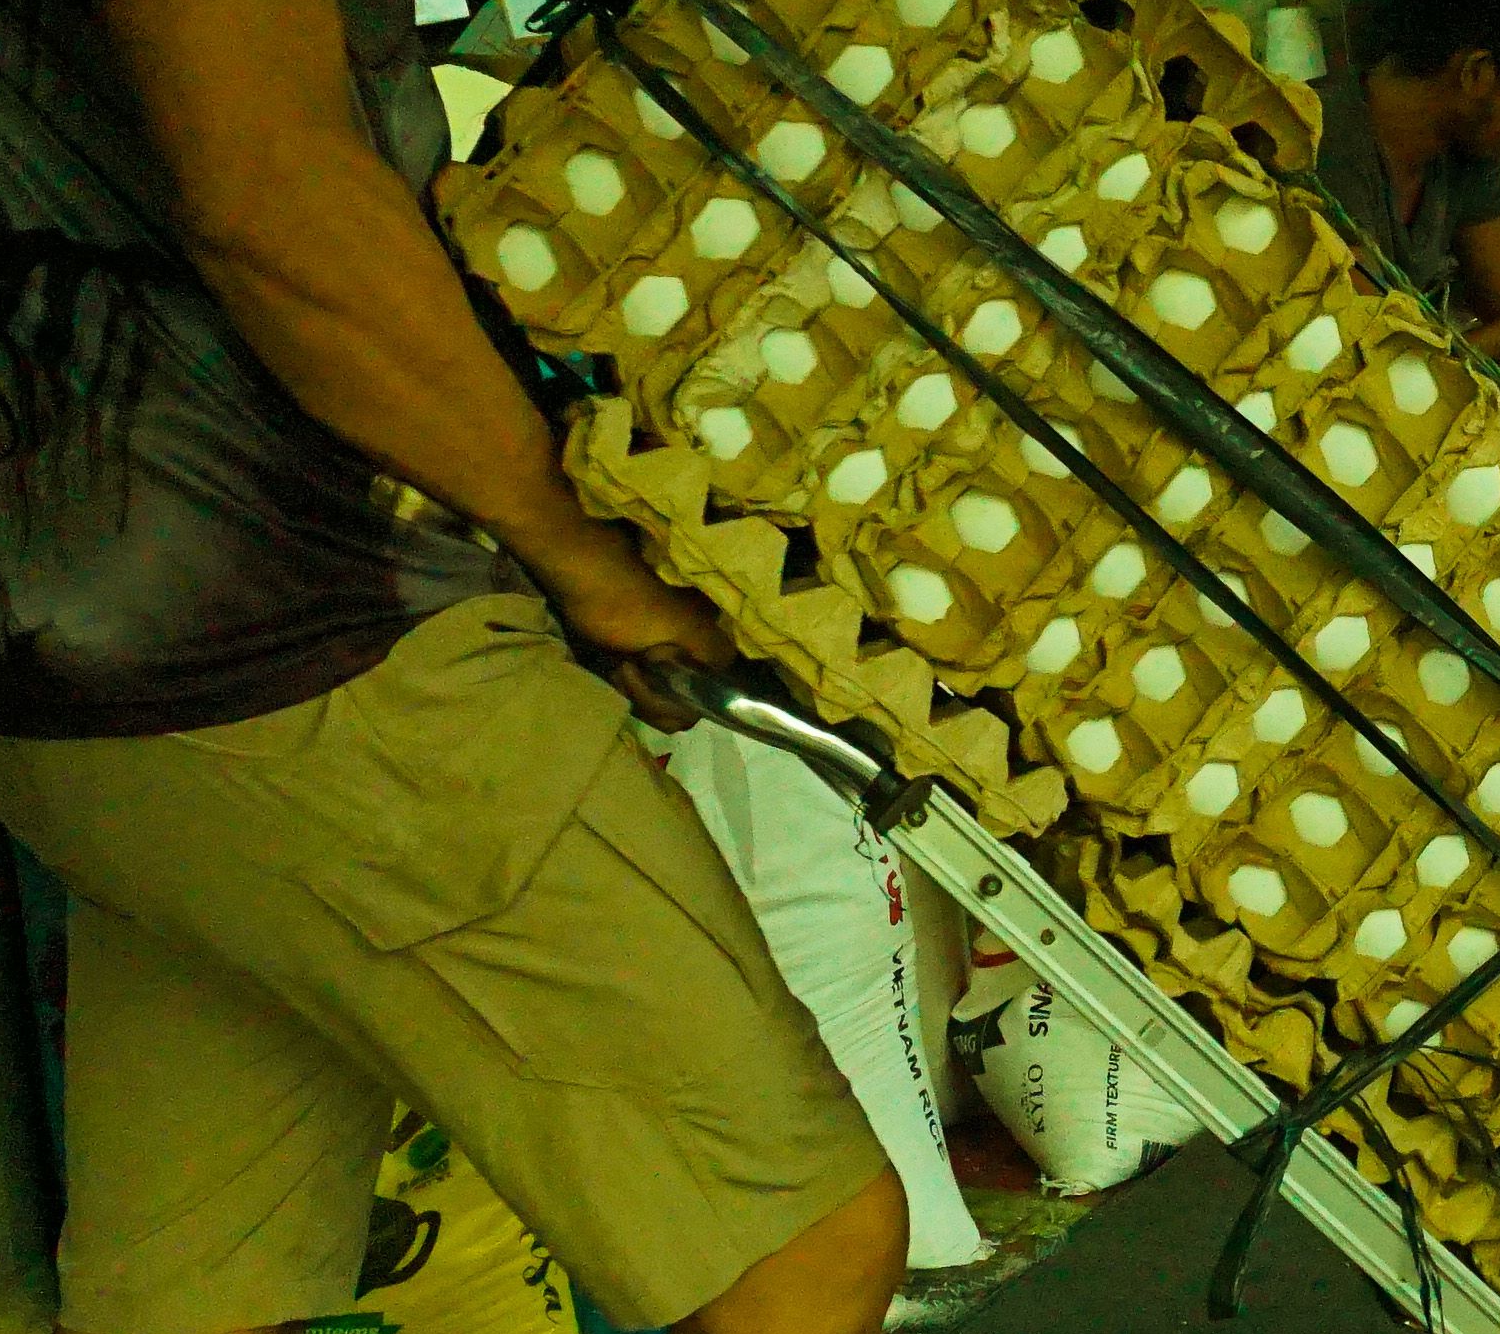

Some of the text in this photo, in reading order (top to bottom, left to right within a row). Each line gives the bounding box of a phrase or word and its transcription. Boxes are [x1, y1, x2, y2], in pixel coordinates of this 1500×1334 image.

[891, 945, 923, 1081] VIETNAM
[918, 1087, 949, 1163] RICE
[1027, 1063, 1046, 1136] KYLO
[1106, 1043, 1123, 1151] FIRM TEXTURE
